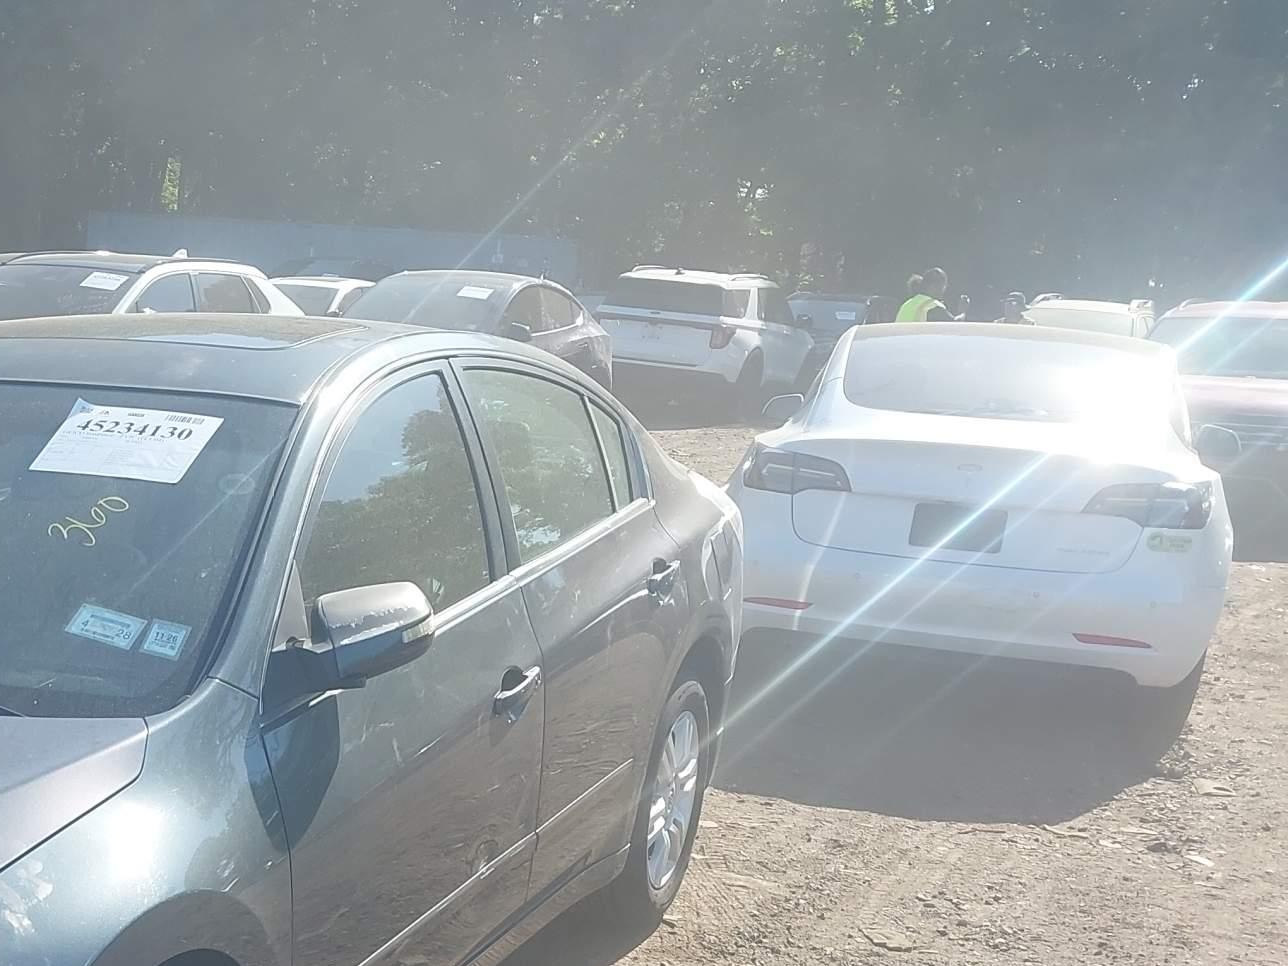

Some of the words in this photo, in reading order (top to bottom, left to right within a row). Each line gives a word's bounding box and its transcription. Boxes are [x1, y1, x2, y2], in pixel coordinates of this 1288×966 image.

[76, 418, 194, 442] 45234130
[48, 496, 129, 547] 360
[115, 629, 132, 641] 28
